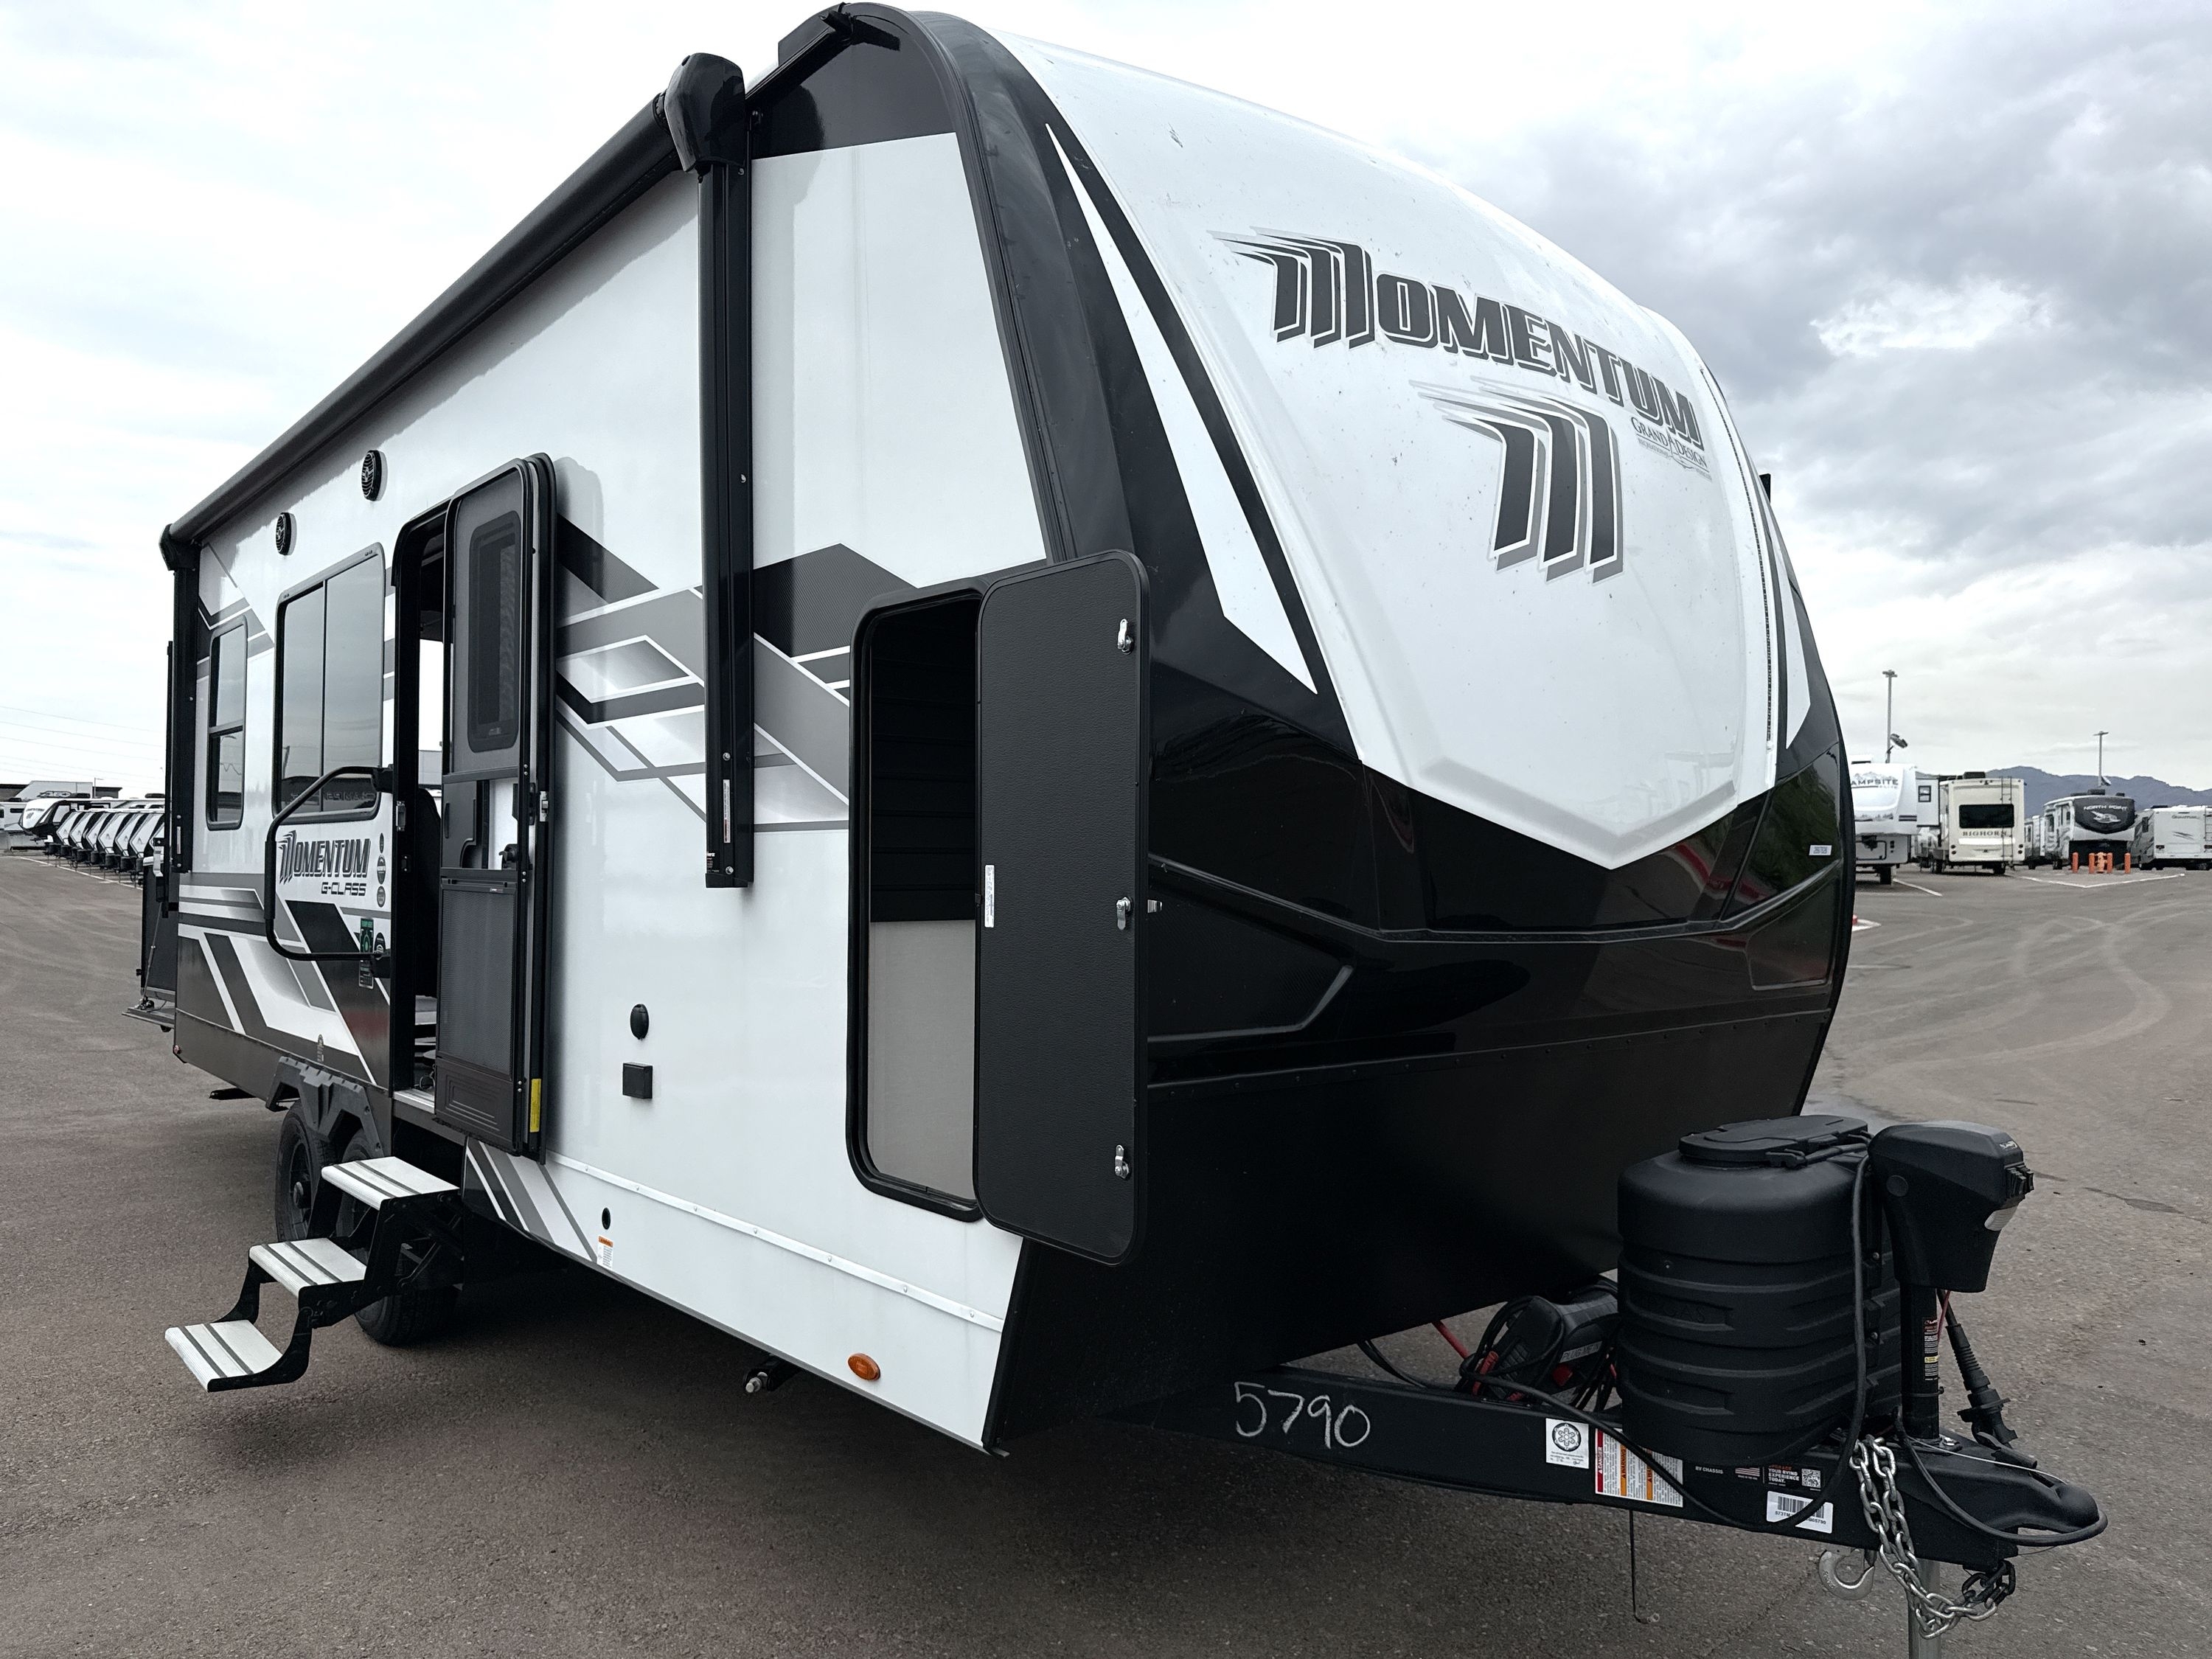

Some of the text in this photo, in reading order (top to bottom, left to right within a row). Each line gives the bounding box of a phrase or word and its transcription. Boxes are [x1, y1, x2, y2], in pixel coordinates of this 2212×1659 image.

[1208, 227, 1705, 451] MOMENTUM
[1631, 417, 1668, 446] GRAND
[1674, 439, 1708, 468] DESIGN
[278, 830, 372, 885] MOMENTUM
[321, 882, 367, 897] G-CLASS
[1234, 1381, 1371, 1449] 5790
[1768, 1472, 1800, 1481] EXPERIENCE
